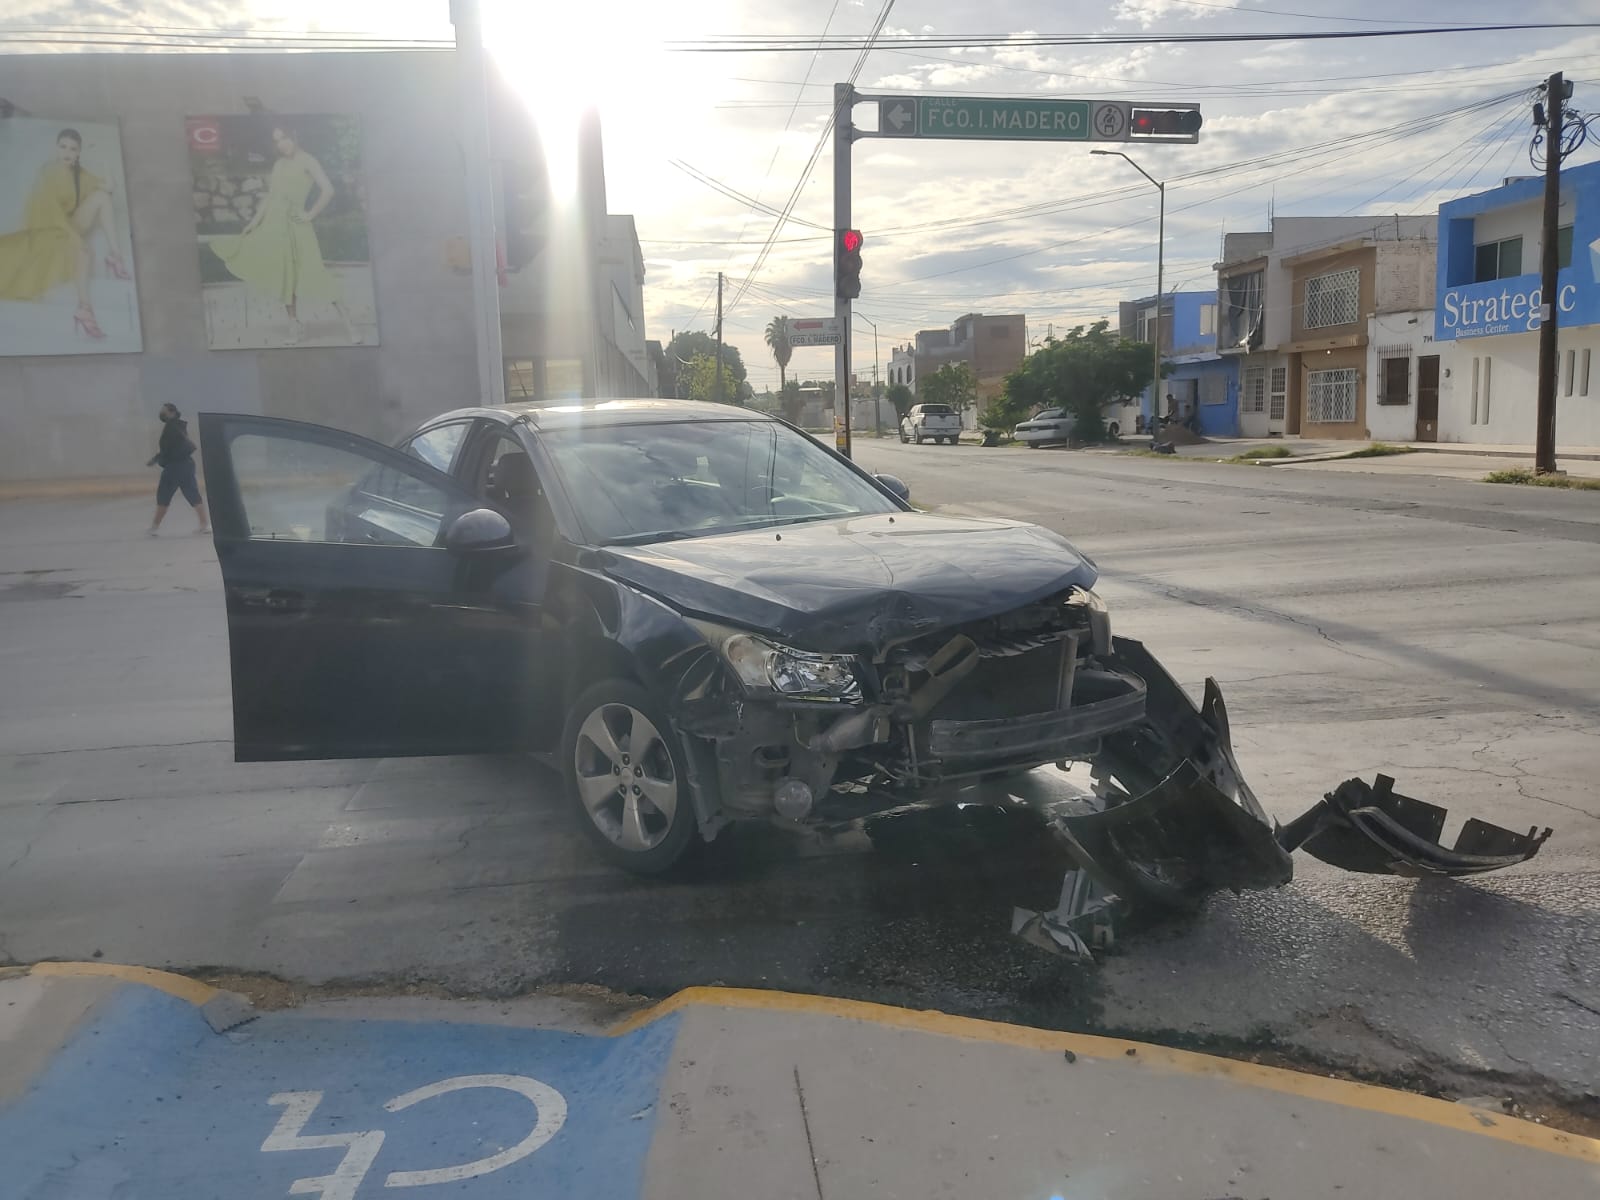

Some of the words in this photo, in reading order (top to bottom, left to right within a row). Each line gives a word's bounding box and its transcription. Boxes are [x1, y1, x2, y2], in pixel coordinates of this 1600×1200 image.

[992, 110, 1081, 130] MADERO
[193, 127, 217, 143] C
[1443, 284, 1576, 331] Strategc
[1456, 327, 1484, 338] Business
[1485, 323, 1510, 335] Center
